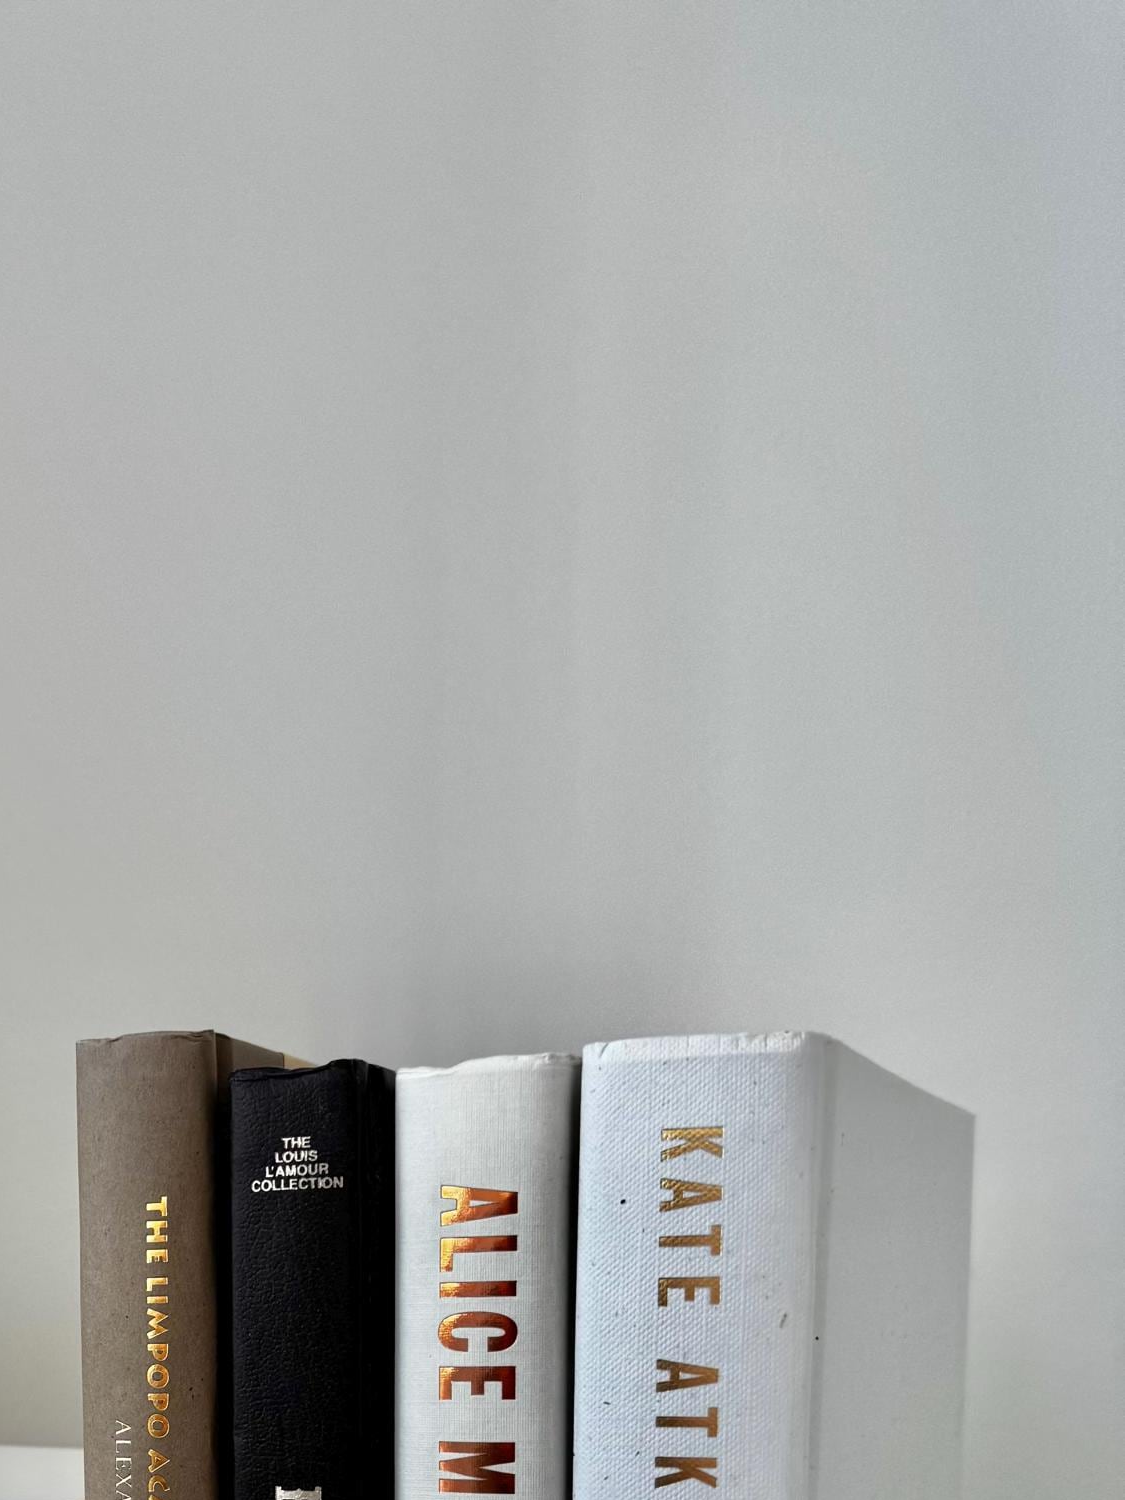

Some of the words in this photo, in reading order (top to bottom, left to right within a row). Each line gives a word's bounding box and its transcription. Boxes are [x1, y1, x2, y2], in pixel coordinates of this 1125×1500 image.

[275, 1150, 318, 1163] LOUIS
[281, 1136, 311, 1149] THE
[251, 1176, 344, 1192] COLLECTION
[265, 1163, 329, 1178] L'AMOUR
[146, 1196, 169, 1264] THE
[657, 1125, 724, 1307] KATE
[437, 1184, 519, 1401] ALICE
[146, 1276, 170, 1439] LIMPOPO
